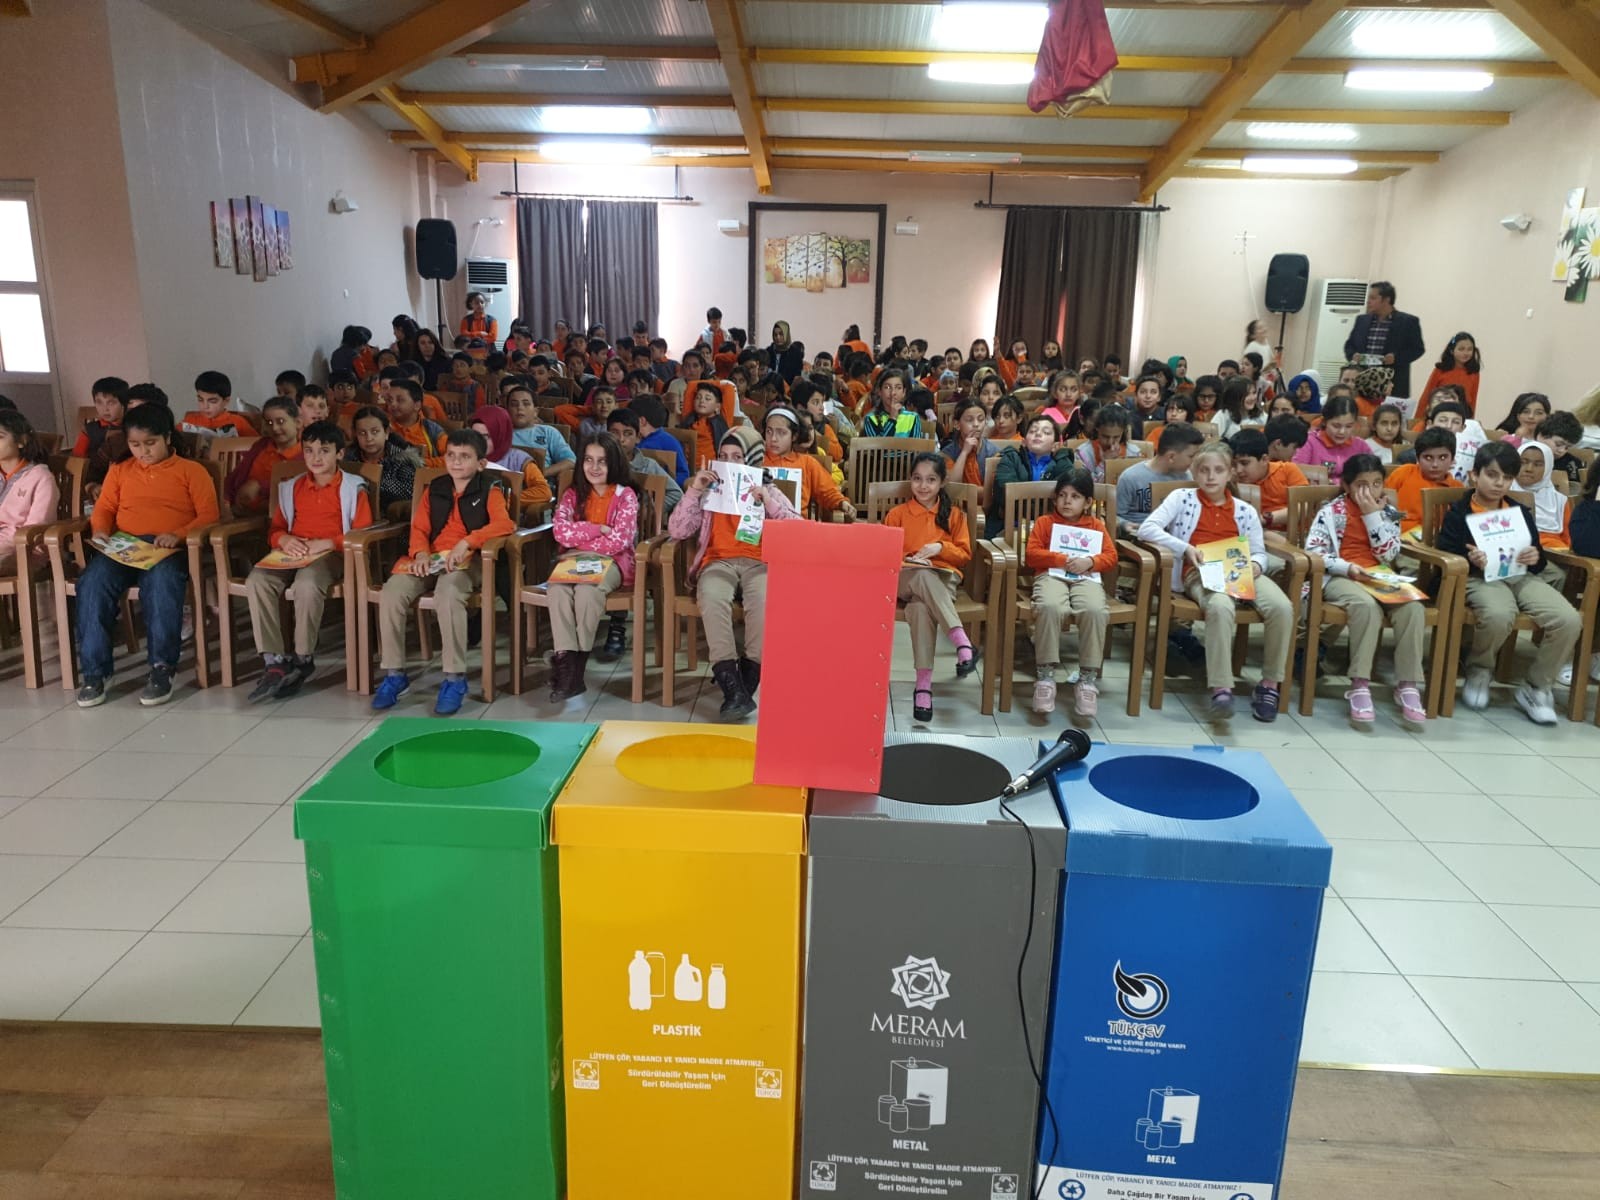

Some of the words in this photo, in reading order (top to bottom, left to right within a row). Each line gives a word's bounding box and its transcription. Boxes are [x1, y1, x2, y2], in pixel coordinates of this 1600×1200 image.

[652, 1024, 702, 1037] PLASTİK
[870, 1012, 967, 1040] MERAM
[1107, 1019, 1166, 1040] TÜKÇEV
[892, 1036, 944, 1048] BELEDİYESİ
[1084, 1035, 1113, 1044] TÜKETİCİ
[589, 1052, 615, 1061] LÜTFEN
[633, 1055, 662, 1063] YABANCI
[664, 1056, 673, 1064] VE
[683, 1072, 709, 1081] Yaşam
[711, 1072, 726, 1081] İçin
[642, 1080, 658, 1088] Geri
[660, 1081, 712, 1091] Dönüştürelim
[893, 1139, 930, 1151] METAL
[827, 1154, 853, 1164] LÜTFEN
[870, 1158, 900, 1167] YABANCI
[901, 1161, 911, 1169] VE
[912, 1162, 935, 1170] YANICI
[936, 1164, 961, 1172] MADDE
[1147, 1154, 1177, 1165] METAL
[920, 1176, 946, 1186] Yaşam
[947, 1176, 963, 1187] İçin
[1075, 1172, 1100, 1180] LÜTFEN
[1116, 1176, 1145, 1184] YABANCI
[878, 1183, 895, 1192] Geri
[896, 1184, 948, 1195] Dönüştürelim
[1107, 1188, 1126, 1196] Daha
[1127, 1190, 1153, 1199] Çağdaş
[1154, 1192, 1165, 1200] Bir
